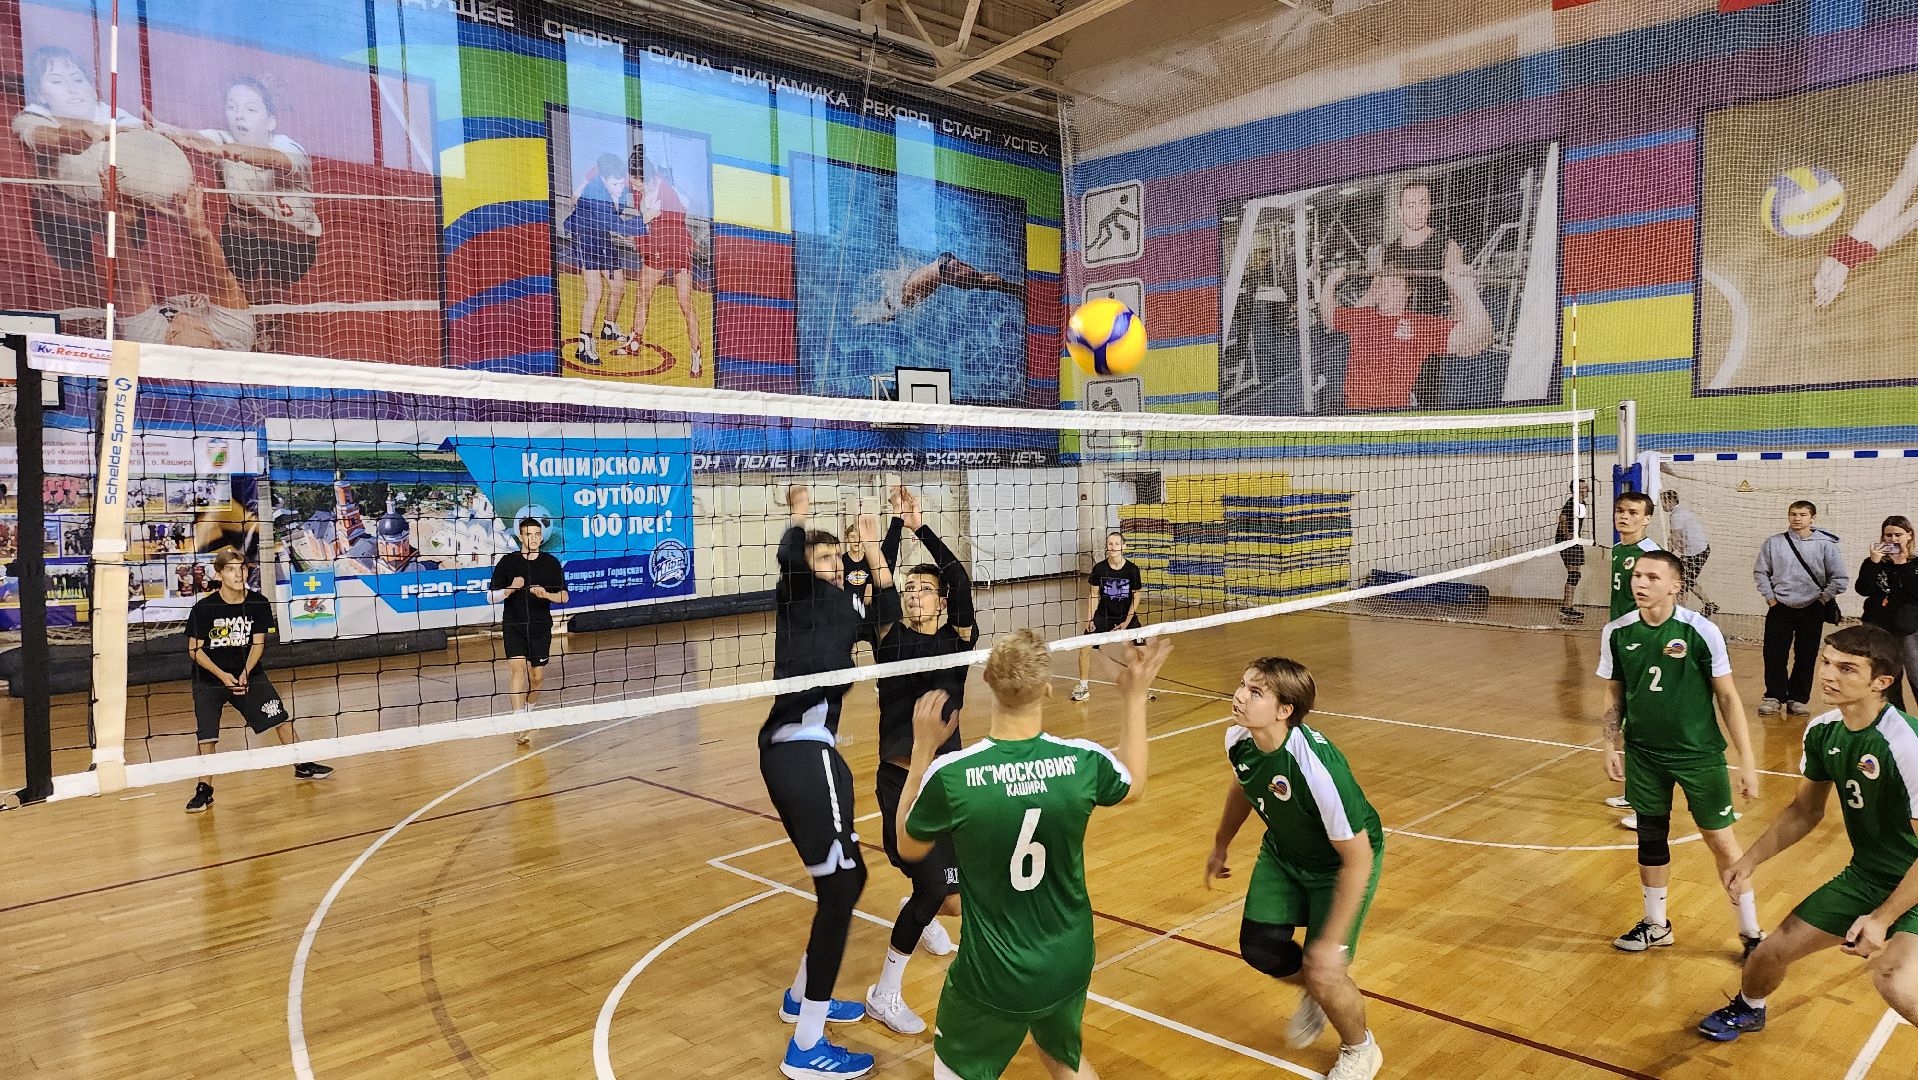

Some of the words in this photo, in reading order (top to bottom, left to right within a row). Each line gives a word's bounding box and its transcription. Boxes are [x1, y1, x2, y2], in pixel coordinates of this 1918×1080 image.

[543, 18, 628, 54] СПОРТ
[647, 45, 714, 75] СИЛА
[731, 65, 850, 107] ДИНАМИКА
[863, 99, 932, 131] РЕКОРД
[942, 118, 992, 143] СТАРТ
[1003, 133, 1049, 157] УСПЕХ
[111, 393, 129, 442] Sports
[161, 458, 193, 467] Кашира
[521, 453, 671, 478] Каширскому
[735, 454, 800, 469] ПОЛЕТ
[813, 453, 914, 468] ГАРМОНИЯ
[926, 452, 1000, 465] СКОРОСТЬ
[1010, 451, 1046, 465] ЦЕЛЬ
[105, 445, 122, 505] Schelde
[581, 513, 622, 538] 100
[628, 510, 673, 534] лет!
[401, 579, 493, 600] 1920-20
[1613, 572, 1621, 591] 5
[1648, 665, 1663, 692] 2
[1005, 780, 1048, 797] КАШИРА
[1845, 779, 1864, 809] 3
[1009, 807, 1047, 892] 6
